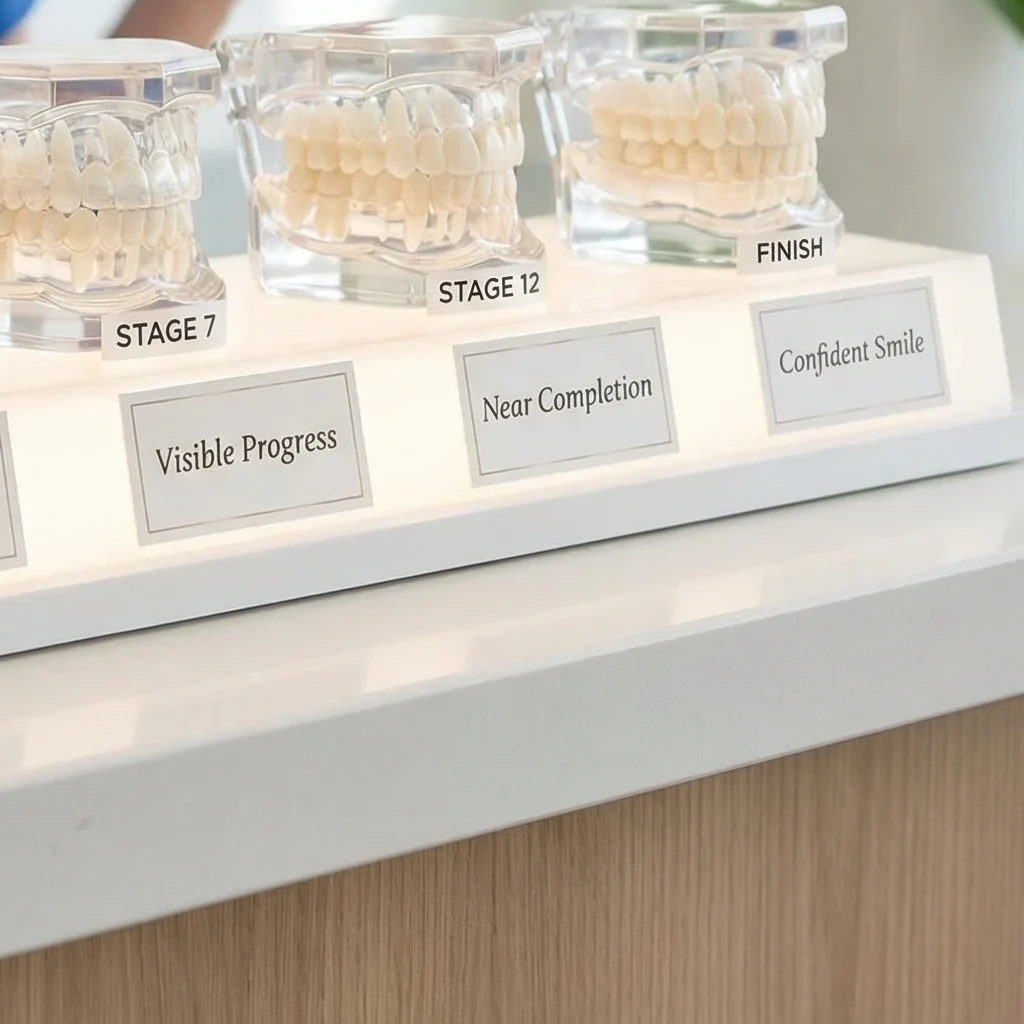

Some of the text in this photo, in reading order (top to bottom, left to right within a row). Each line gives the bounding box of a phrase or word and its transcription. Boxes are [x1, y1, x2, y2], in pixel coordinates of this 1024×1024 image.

[757, 236, 823, 263] FINISH
[438, 271, 540, 304] STAGE 12
[116, 313, 217, 348] STAGE 7
[779, 328, 925, 377] Confident Smile
[482, 375, 653, 423] Near Completion
[155, 429, 337, 475] Visible Progress
